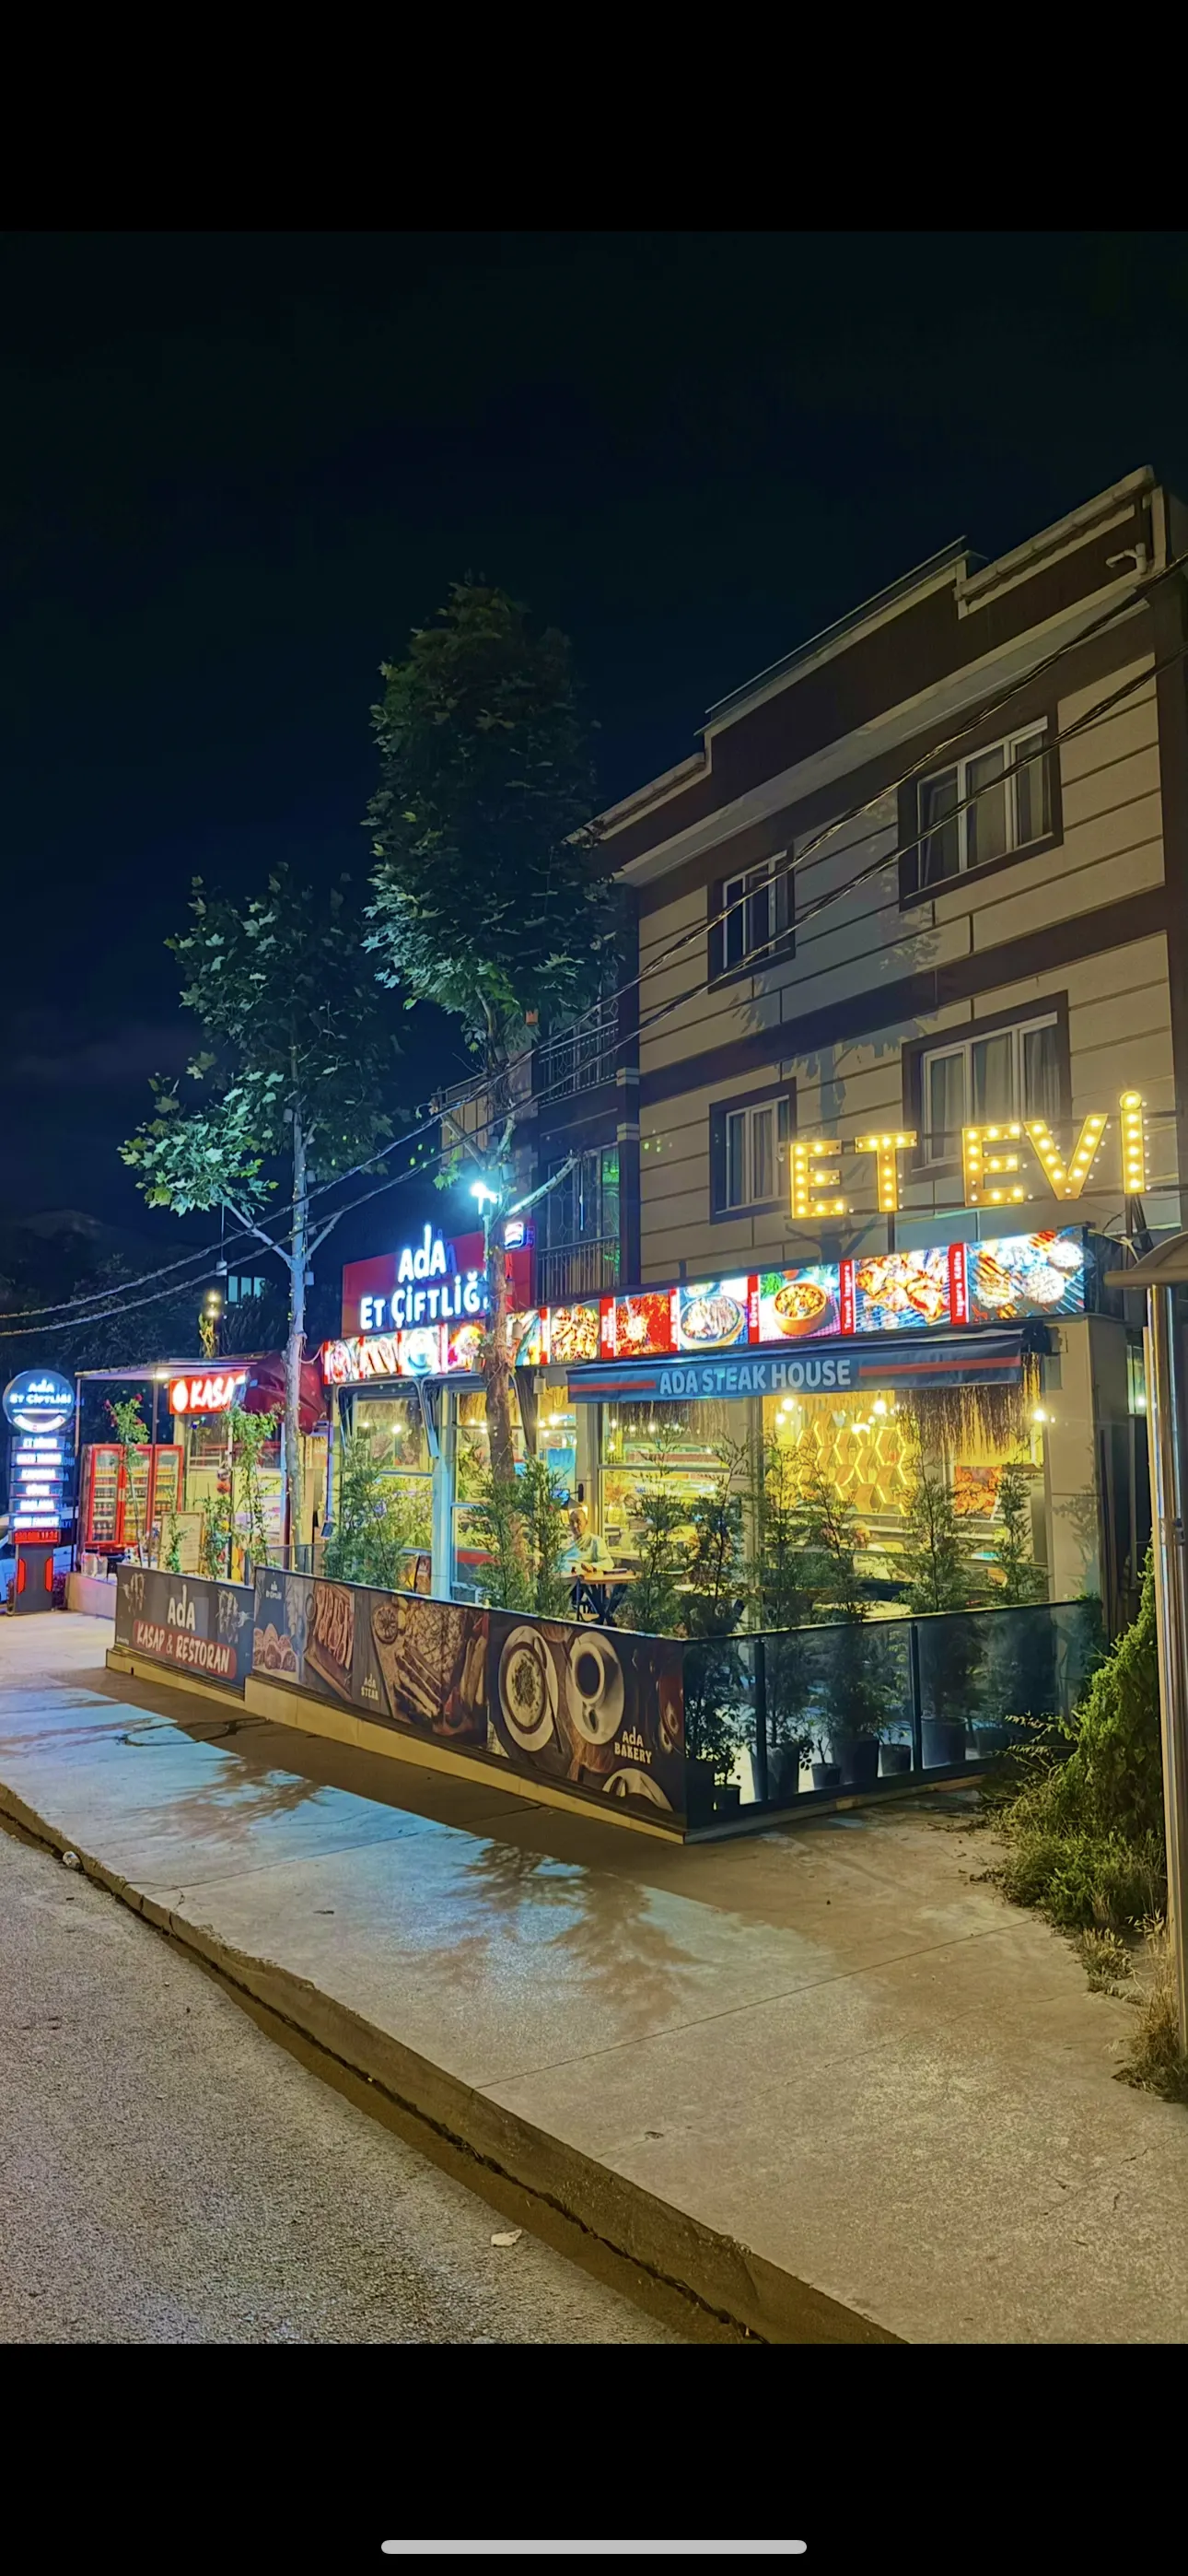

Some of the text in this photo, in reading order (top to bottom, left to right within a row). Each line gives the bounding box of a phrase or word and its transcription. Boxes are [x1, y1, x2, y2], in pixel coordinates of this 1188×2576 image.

[789, 1091, 1146, 1220] ET EVİ
[360, 1296, 386, 1330] ET
[659, 1359, 851, 1395] ADA STEAK HOUSE
[136, 1622, 230, 1674] KASAP & RESTORAN
[614, 1741, 652, 1764] BAKERY
